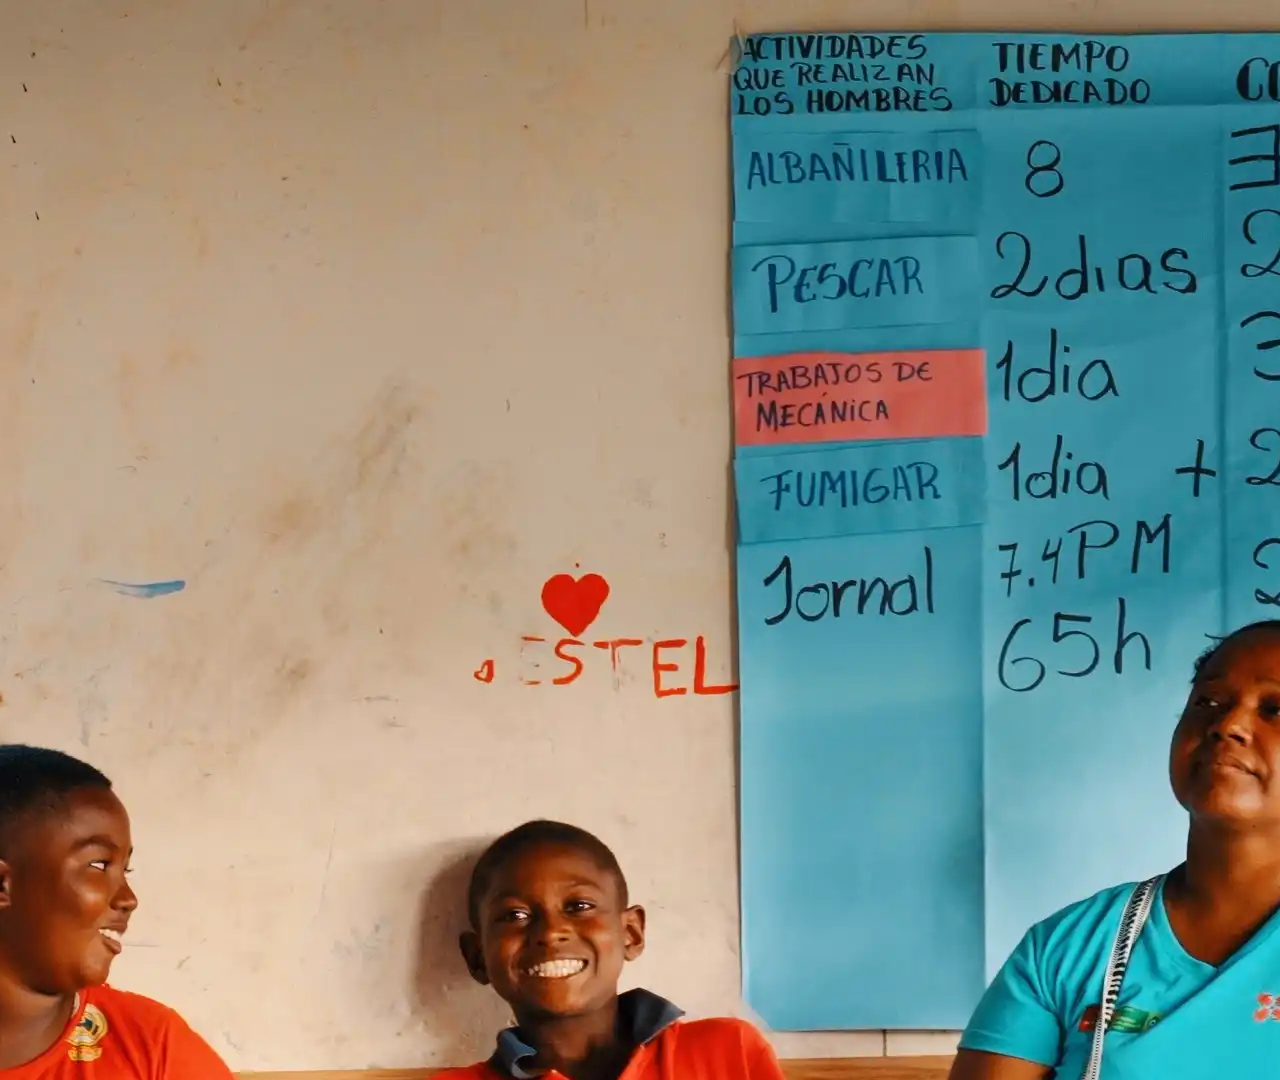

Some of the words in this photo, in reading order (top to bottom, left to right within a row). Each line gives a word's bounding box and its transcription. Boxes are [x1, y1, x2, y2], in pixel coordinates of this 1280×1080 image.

[744, 35, 928, 62] ACTIVIDADES
[992, 40, 1130, 73] TIEMPO
[734, 66, 786, 90] QUE
[790, 62, 934, 86] REALIZAN
[988, 77, 1151, 106] DEDICADO
[737, 91, 794, 116] LOS
[807, 87, 953, 113] HOMBRES
[1025, 140, 1064, 197] 8
[751, 254, 924, 313] PESCAR
[736, 361, 883, 398] TRABAJOS
[892, 361, 933, 382] DE
[759, 461, 942, 511] FUMIGAR
[998, 597, 1152, 692] 65h
